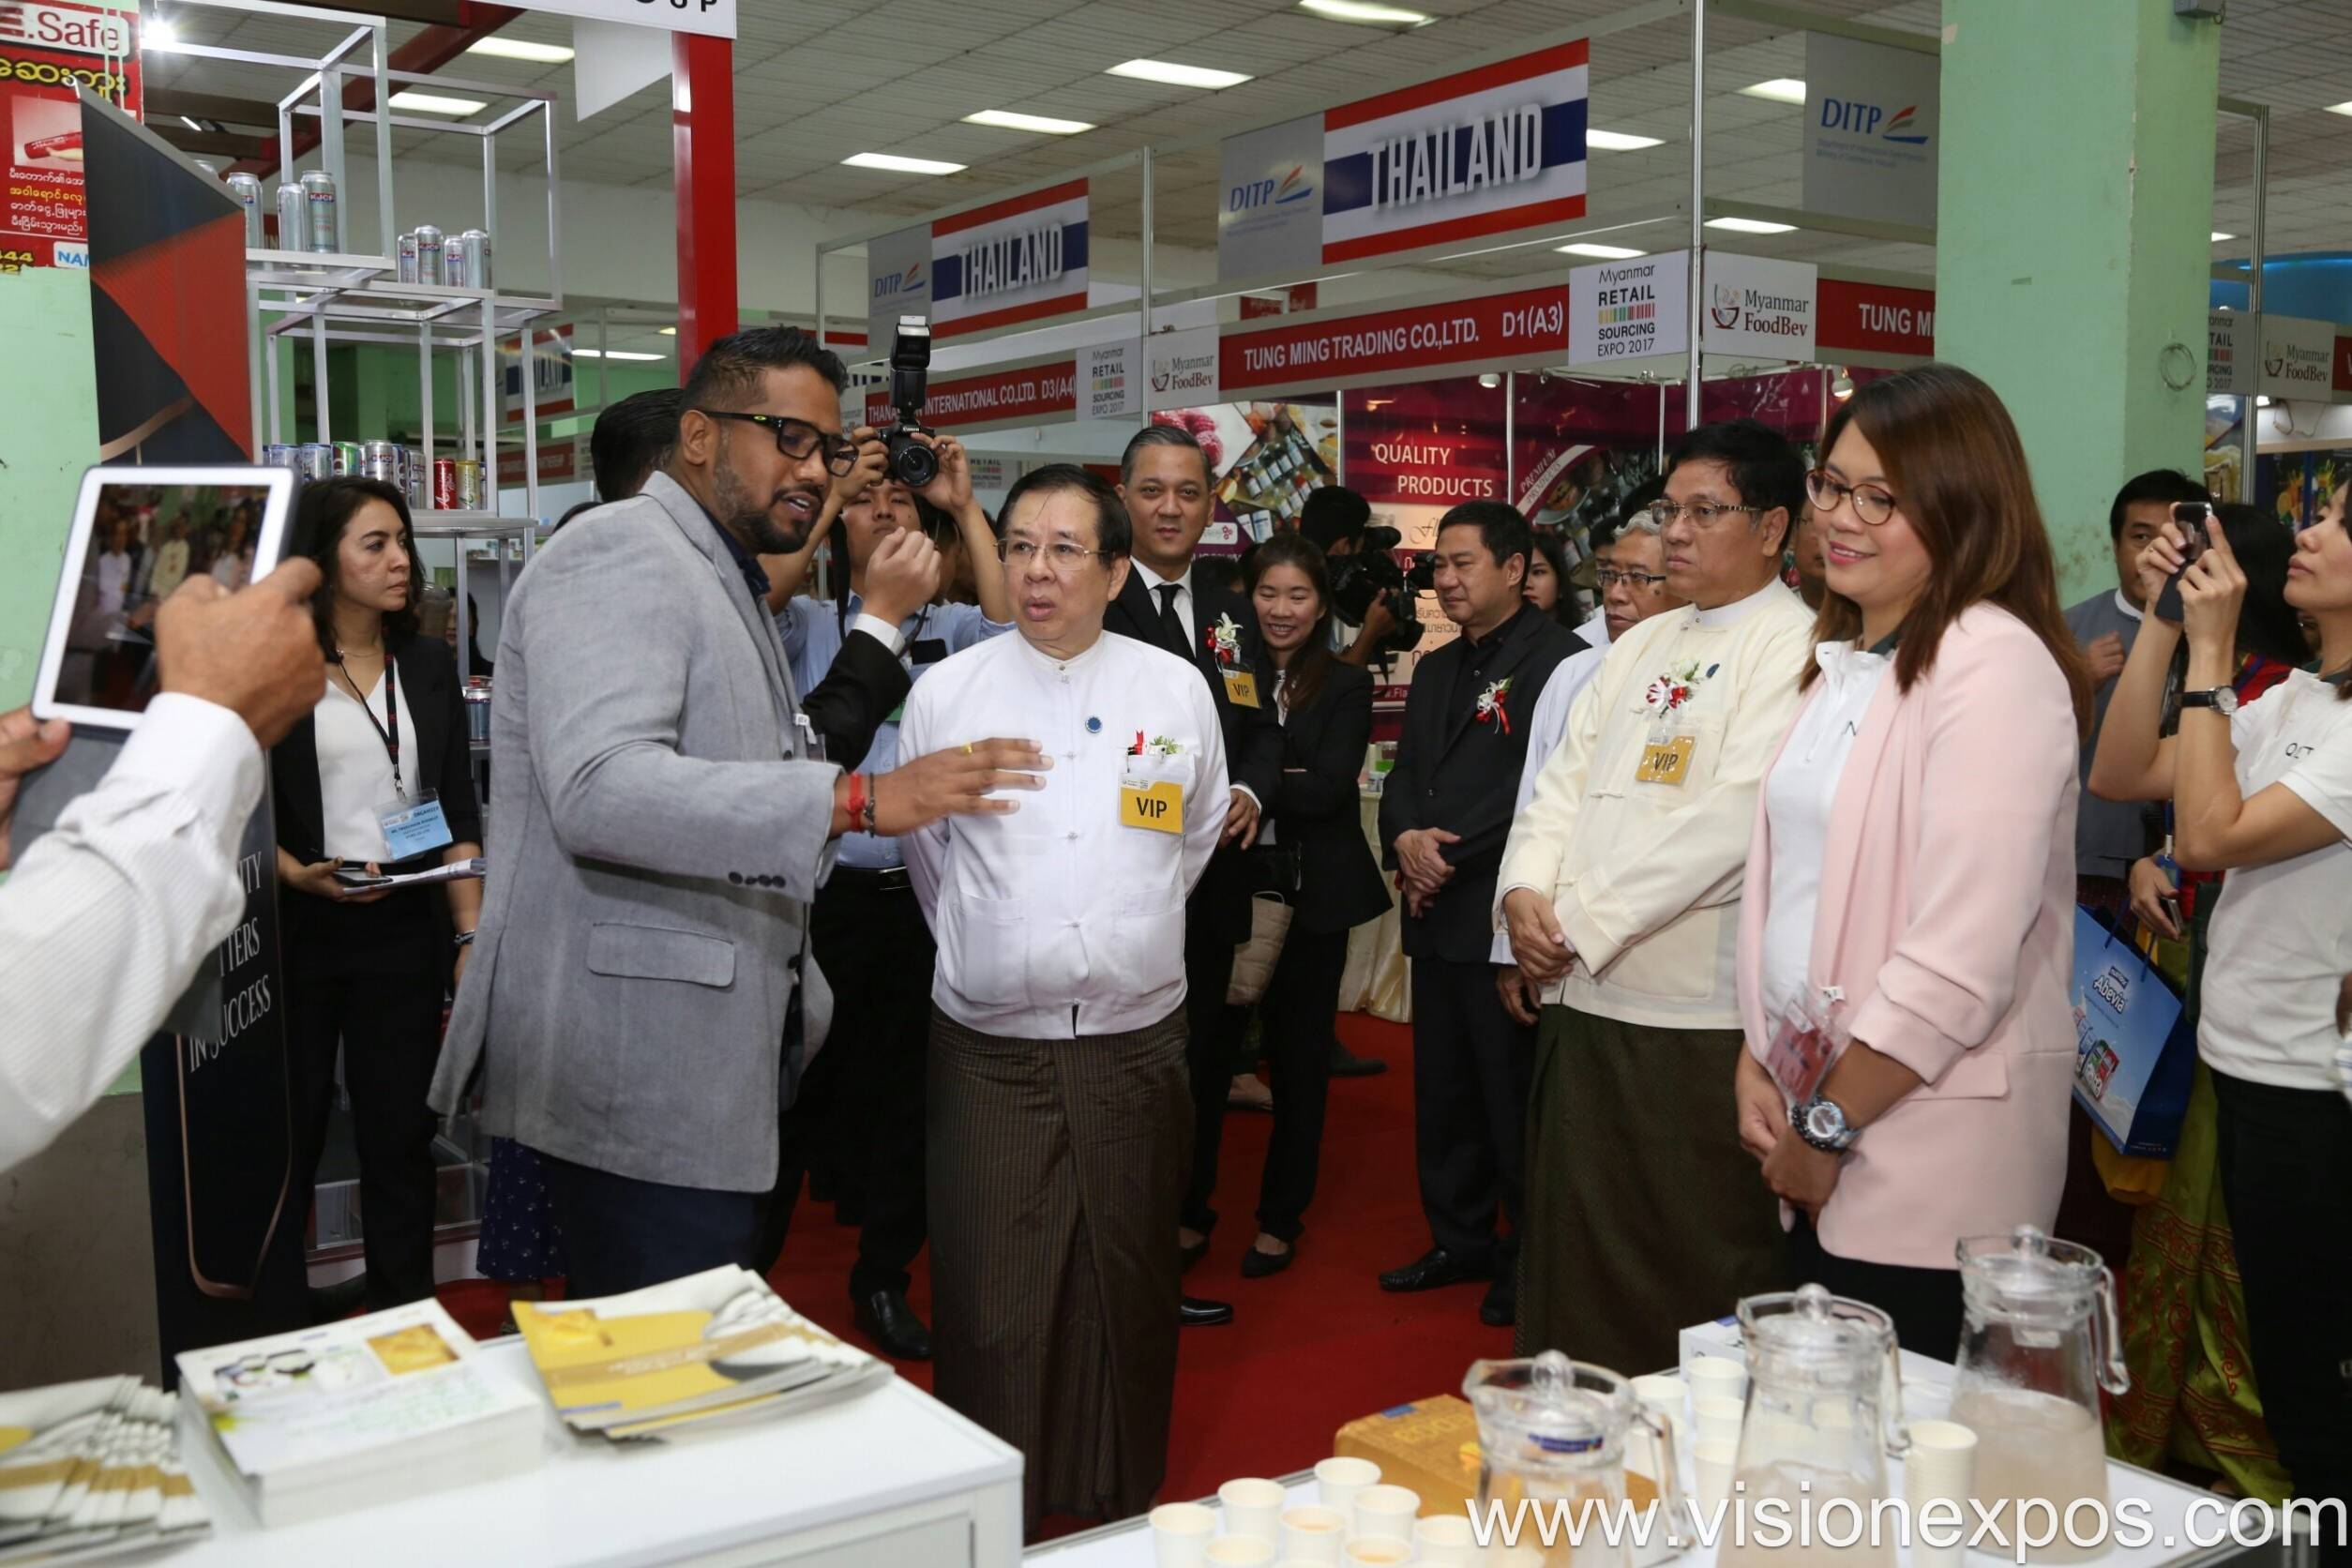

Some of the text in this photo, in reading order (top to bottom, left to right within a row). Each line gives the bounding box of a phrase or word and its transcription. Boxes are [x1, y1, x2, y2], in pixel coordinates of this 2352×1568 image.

[1821, 98, 1882, 134] DITP
[1367, 103, 1543, 211] THAILAND
[1230, 179, 1274, 212] DITP
[957, 223, 1063, 298] THAILAND
[874, 273, 902, 297] DITP
[1599, 264, 1655, 285] Myanmar
[1598, 284, 1655, 307] RETAIL
[1744, 289, 1809, 313] Myanmar
[1744, 312, 1808, 338] FoodBev
[1859, 303, 1911, 334] TUNG
[1244, 344, 1286, 371] TUNG
[1289, 338, 1330, 366] MING
[1332, 326, 1407, 359] TRADING
[1502, 300, 1563, 339] D1(A3)
[1598, 323, 1655, 340] SOURCING
[1597, 338, 1655, 357] EXPO 2017
[2286, 344, 2329, 363] Myanmar
[1093, 362, 1124, 377] RETAIL
[1172, 355, 1214, 373] Myanmar
[2286, 362, 2328, 382] FoodBev
[1172, 372, 1214, 390] FoodBev
[925, 389, 999, 416] INTERNATIONAL
[1042, 373, 1077, 401] D3(A4)
[1093, 390, 1124, 403] SOURCING
[1375, 444, 1451, 465] QUALITY
[1520, 449, 1557, 493] PREMIUM
[1397, 475, 1493, 497] PRODUCTS
[1233, 684, 1250, 697] VIP
[1654, 752, 1679, 771] VIP
[1136, 796, 1168, 819] VIP
[2092, 974, 2126, 1015] Abevia
